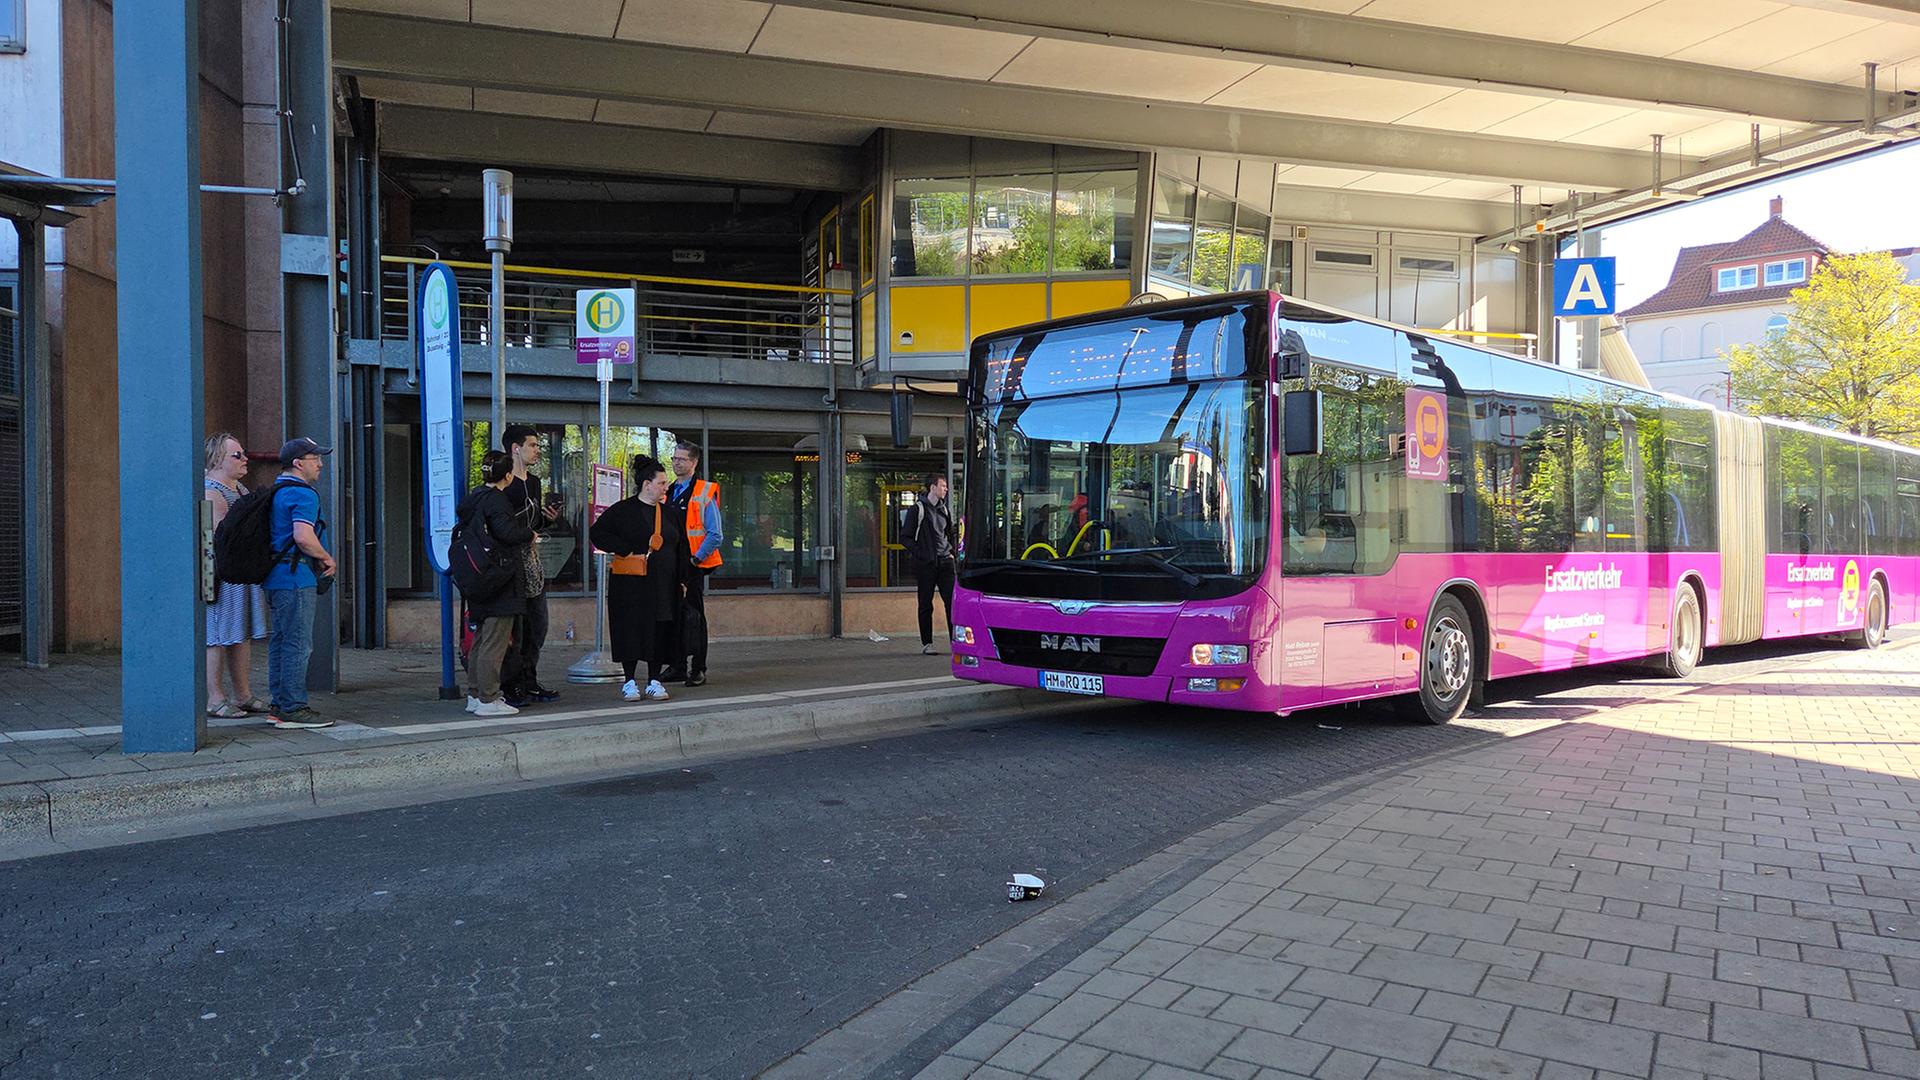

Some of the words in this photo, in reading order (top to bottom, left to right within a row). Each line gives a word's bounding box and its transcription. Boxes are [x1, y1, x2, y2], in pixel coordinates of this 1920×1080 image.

[1562, 264, 1608, 310] A
[597, 301, 613, 324] H
[1545, 562, 1622, 593] Ersatzverkehr
[1787, 561, 1835, 582] Ersatzverkehr
[1040, 634, 1101, 653] MAN
[1045, 673, 1060, 688] HM
[1065, 675, 1079, 690] RQ
[1082, 677, 1102, 691] 115
